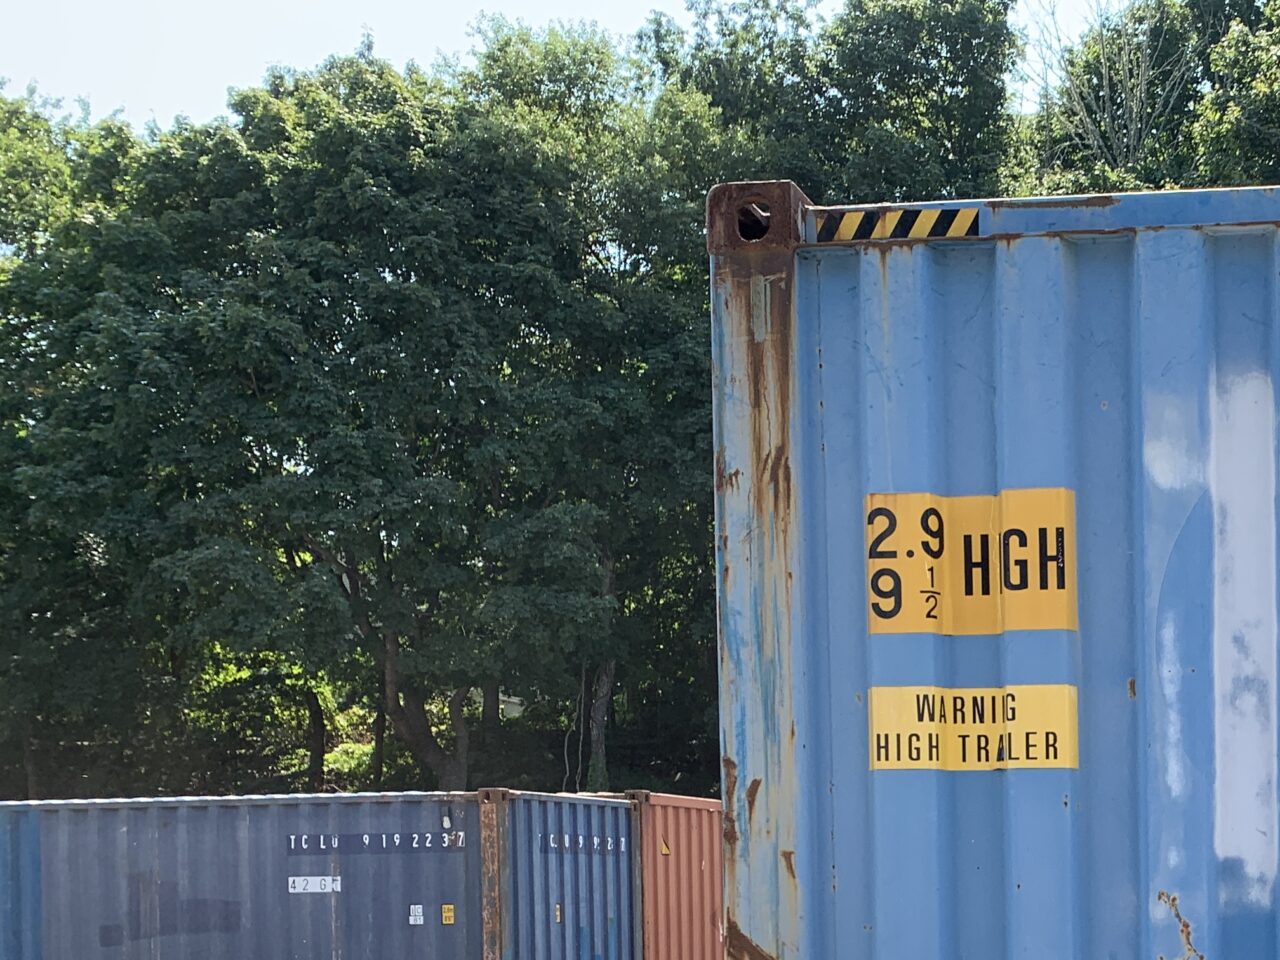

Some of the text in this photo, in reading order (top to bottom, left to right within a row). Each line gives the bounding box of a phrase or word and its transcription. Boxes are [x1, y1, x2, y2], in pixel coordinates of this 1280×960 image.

[867, 507, 945, 561] 2.9
[876, 731, 1060, 763] HIGH TRALER
[289, 833, 339, 850] TCLU
